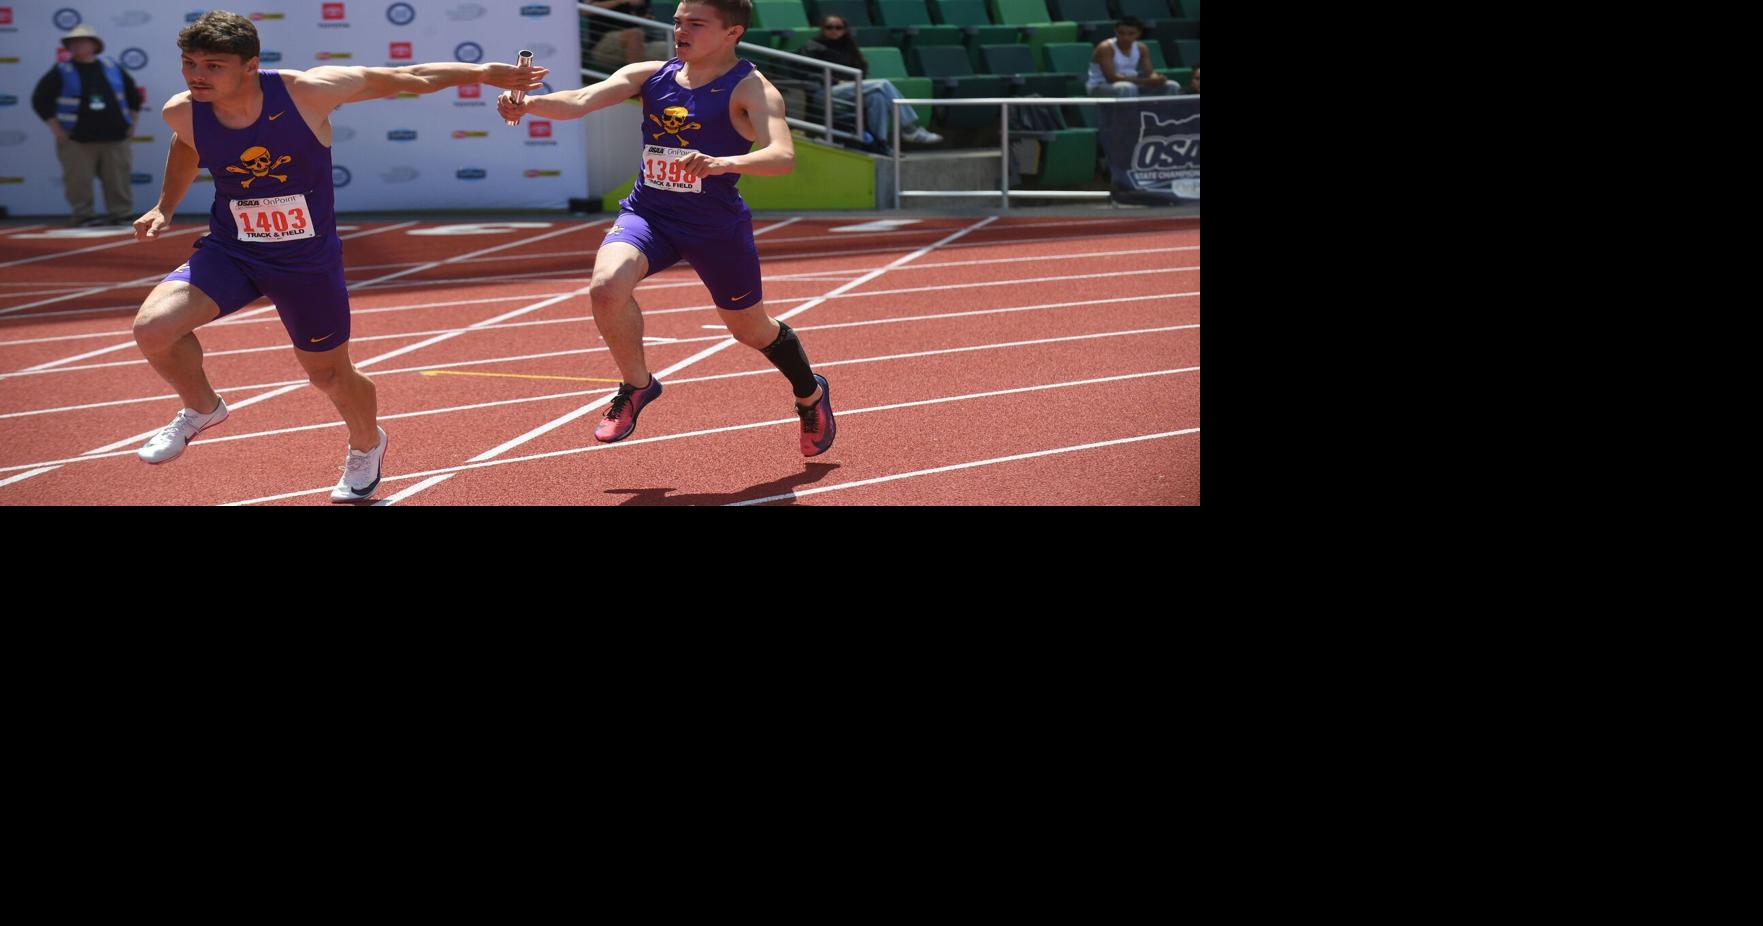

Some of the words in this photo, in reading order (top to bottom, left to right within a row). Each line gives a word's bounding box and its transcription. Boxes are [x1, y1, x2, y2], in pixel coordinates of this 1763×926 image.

[1134, 171, 1157, 180] STATE
[262, 196, 296, 206] OnPoint
[239, 208, 307, 233] 1403
[281, 228, 305, 236] FIELD
